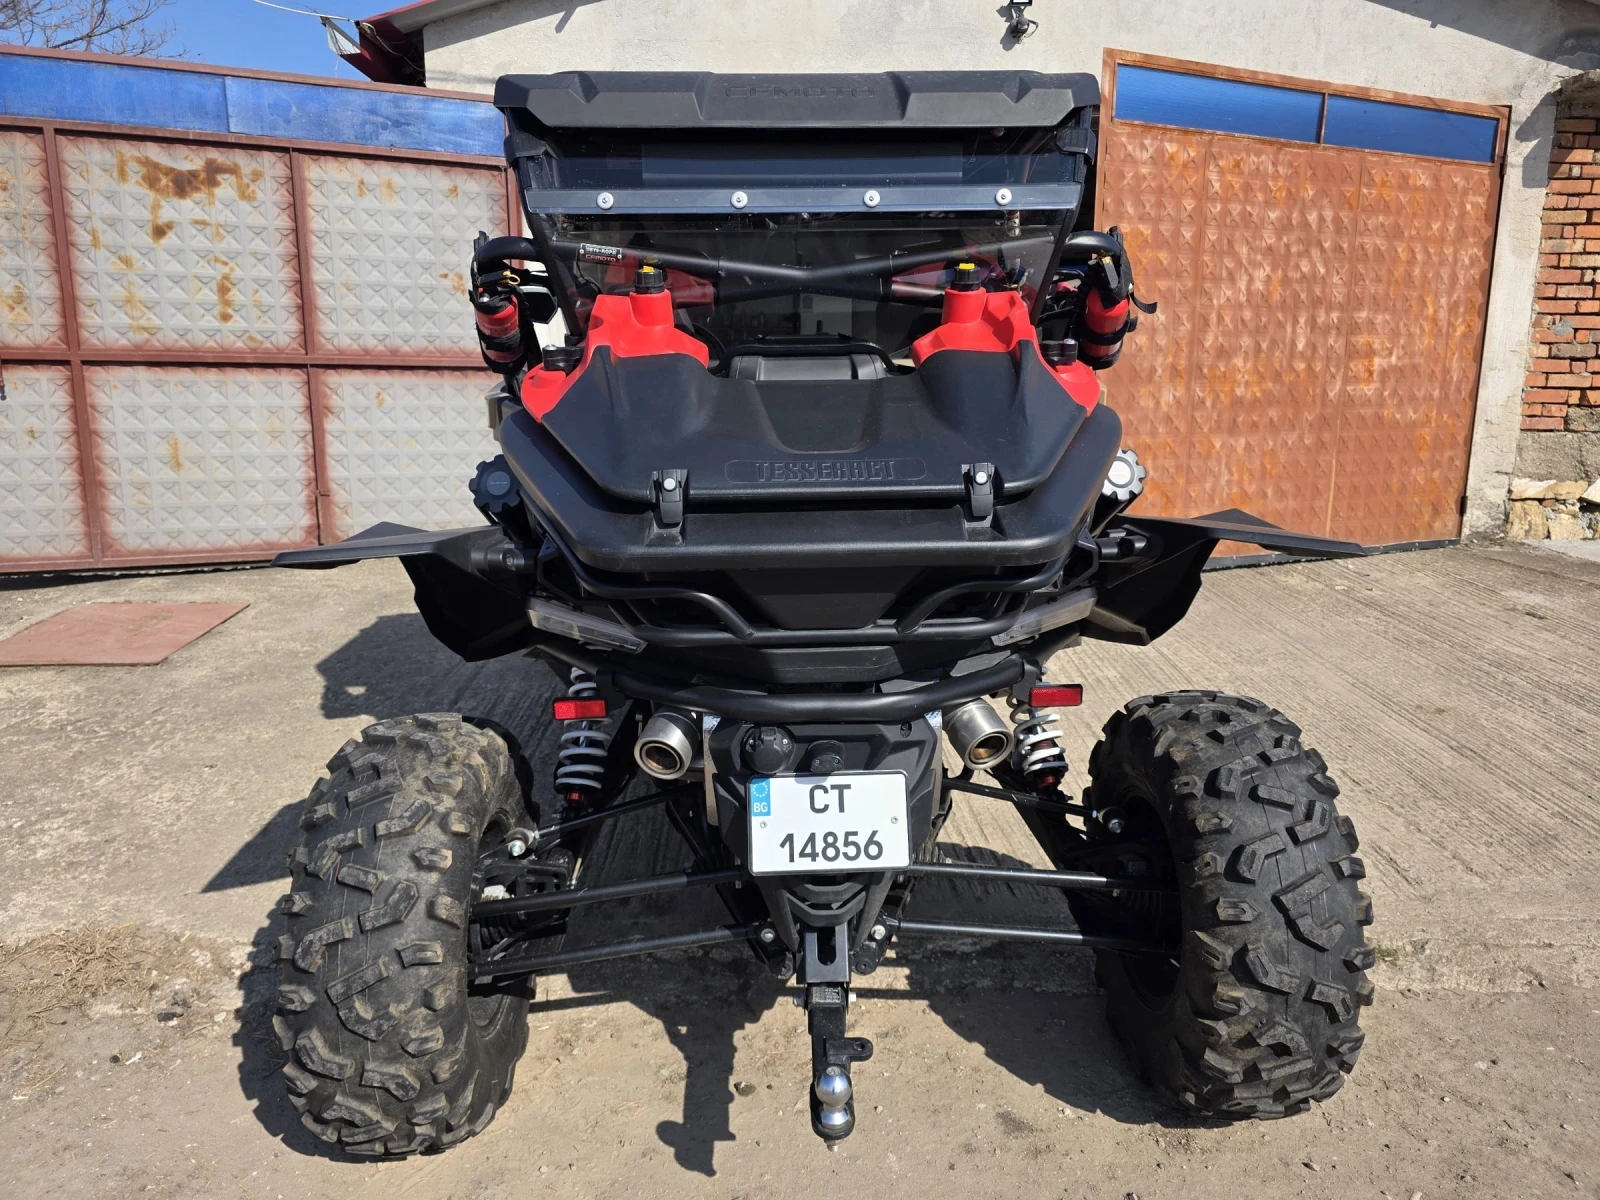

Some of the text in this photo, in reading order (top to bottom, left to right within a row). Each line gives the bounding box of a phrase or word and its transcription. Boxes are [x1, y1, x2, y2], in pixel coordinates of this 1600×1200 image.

[725, 86, 875, 98] CFMOTO
[585, 254, 616, 262] CFMOTO
[756, 460, 895, 482] TESSERACT
[808, 783, 852, 814] CT
[753, 802, 768, 813] BG
[779, 830, 884, 863] 14856
